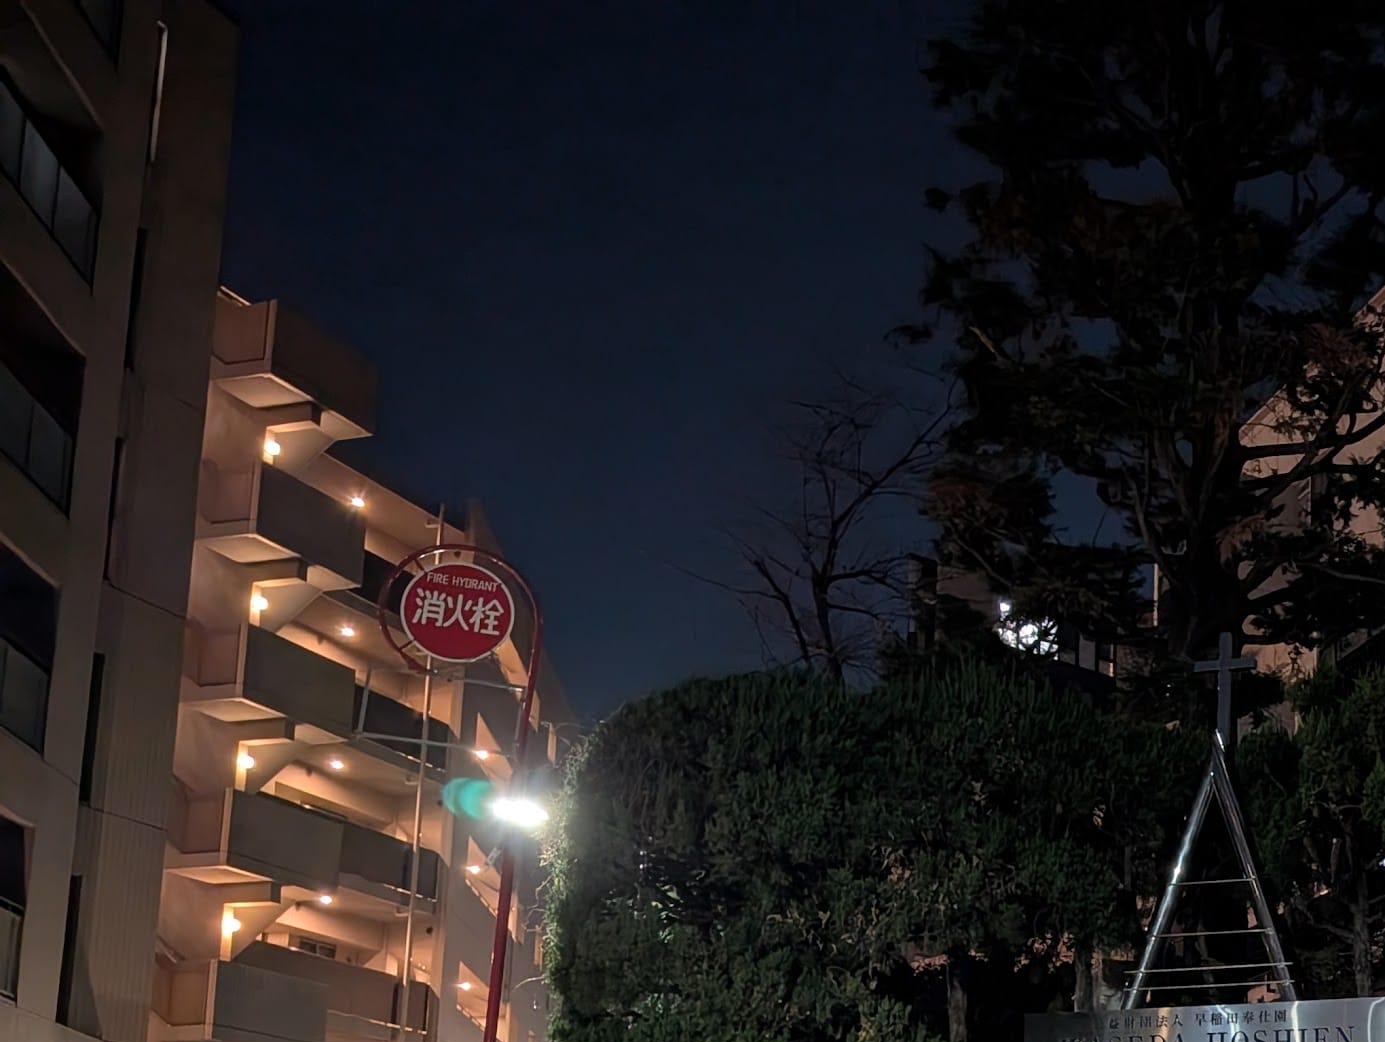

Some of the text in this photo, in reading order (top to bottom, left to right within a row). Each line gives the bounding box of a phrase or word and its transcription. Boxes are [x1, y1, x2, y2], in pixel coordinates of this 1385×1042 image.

[427, 571, 499, 593] FIRE HYDRANT
[412, 587, 504, 636] 消火栓
[1093, 1009, 1288, 1031] 益財団法人 早稲田奉仕園
